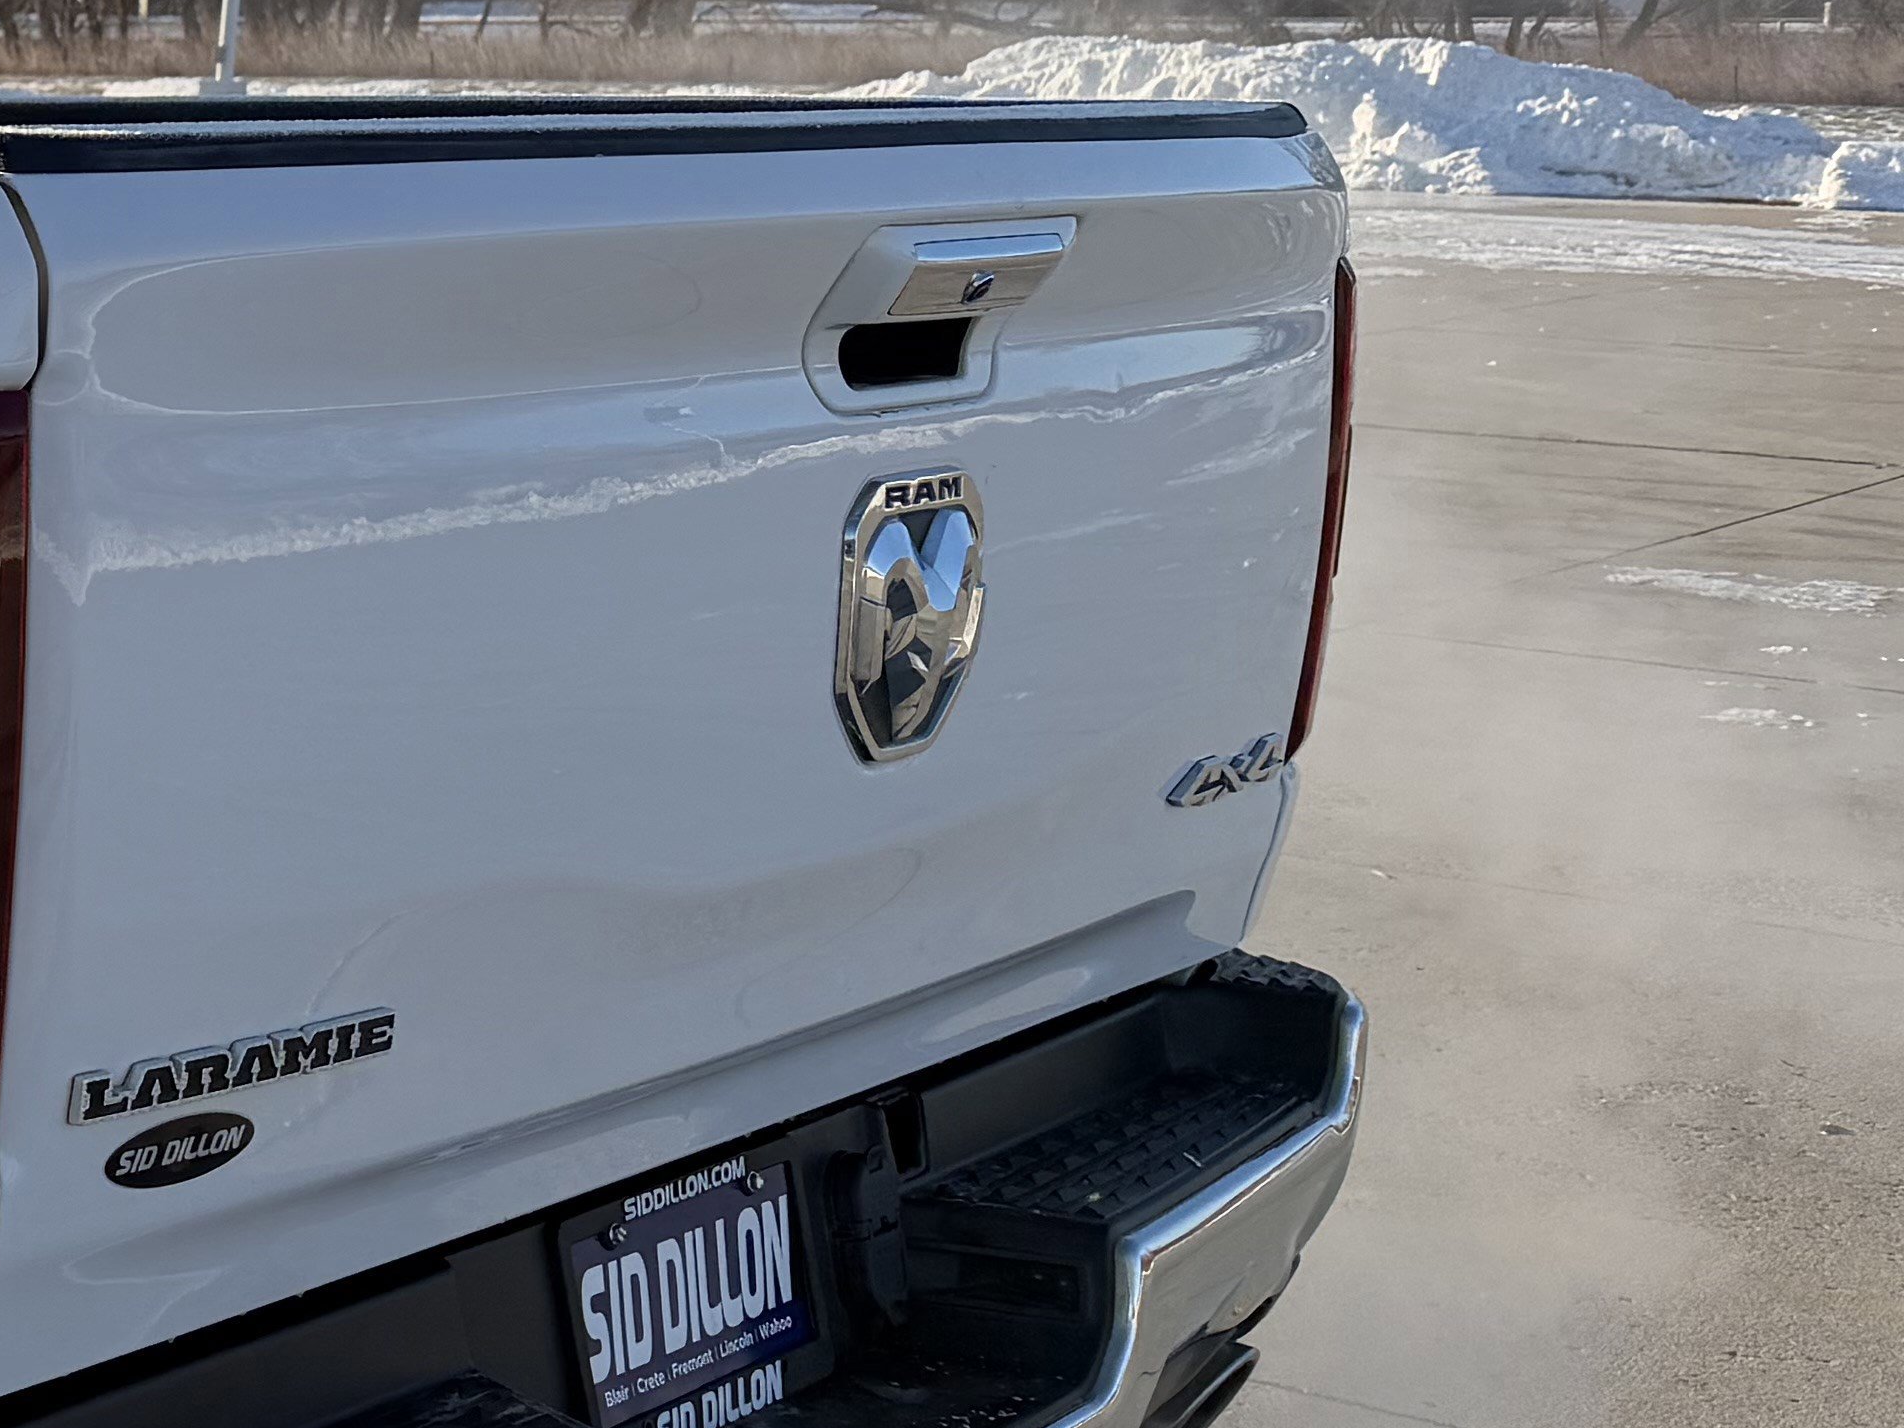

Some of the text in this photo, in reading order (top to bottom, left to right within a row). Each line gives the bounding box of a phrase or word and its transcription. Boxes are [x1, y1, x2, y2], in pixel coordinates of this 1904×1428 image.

[883, 476, 963, 510] RAM
[78, 1010, 396, 1123] LARAMIE
[115, 1124, 246, 1177] SID DILLON
[623, 1155, 747, 1222] SIDDILLON.COM
[580, 1193, 793, 1385] SID DILLON
[604, 1314, 793, 1408] Blair Crete Fremont Lincoln Wahoo
